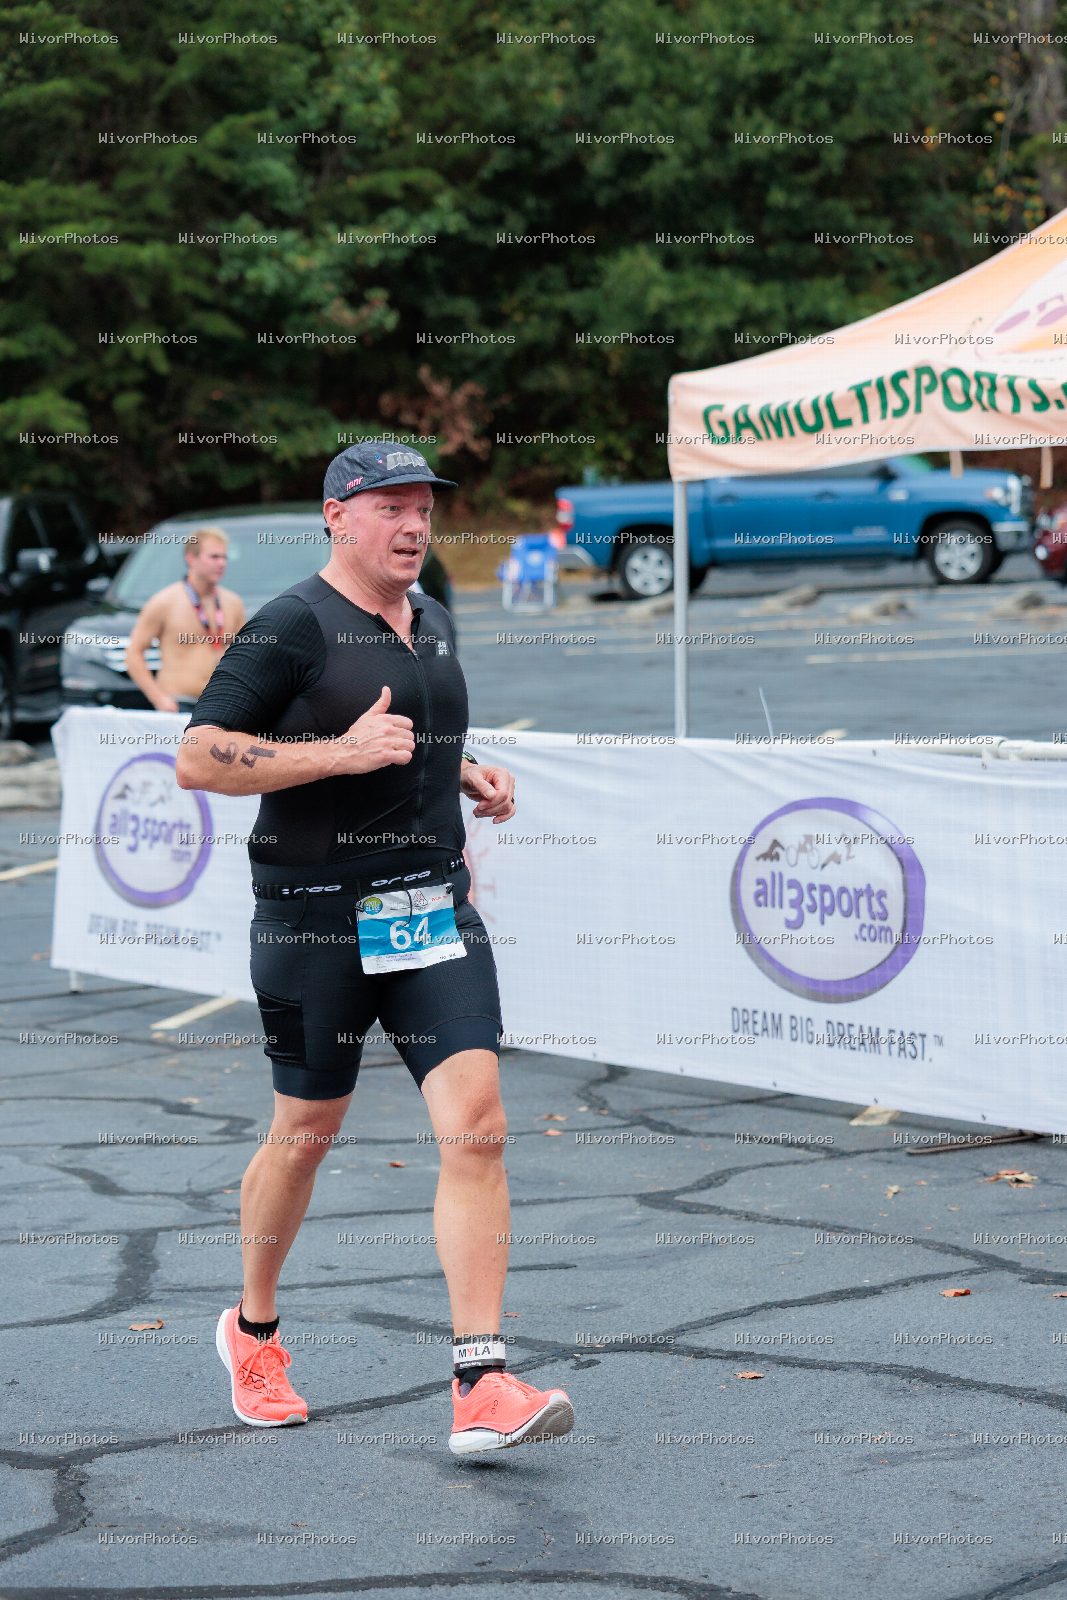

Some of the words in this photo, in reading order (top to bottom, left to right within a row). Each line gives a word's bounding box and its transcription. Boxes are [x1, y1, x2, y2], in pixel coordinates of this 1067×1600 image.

[703, 365, 1067, 443] GAMULTISPORTS.
[209, 742, 277, 768] 64
[754, 871, 889, 930] all3sports
[389, 916, 430, 951] 64
[854, 923, 893, 944] .com
[731, 1007, 783, 1041] DREAM
[826, 1020, 881, 1055] DREAM
[459, 1345, 491, 1358] MYLA
